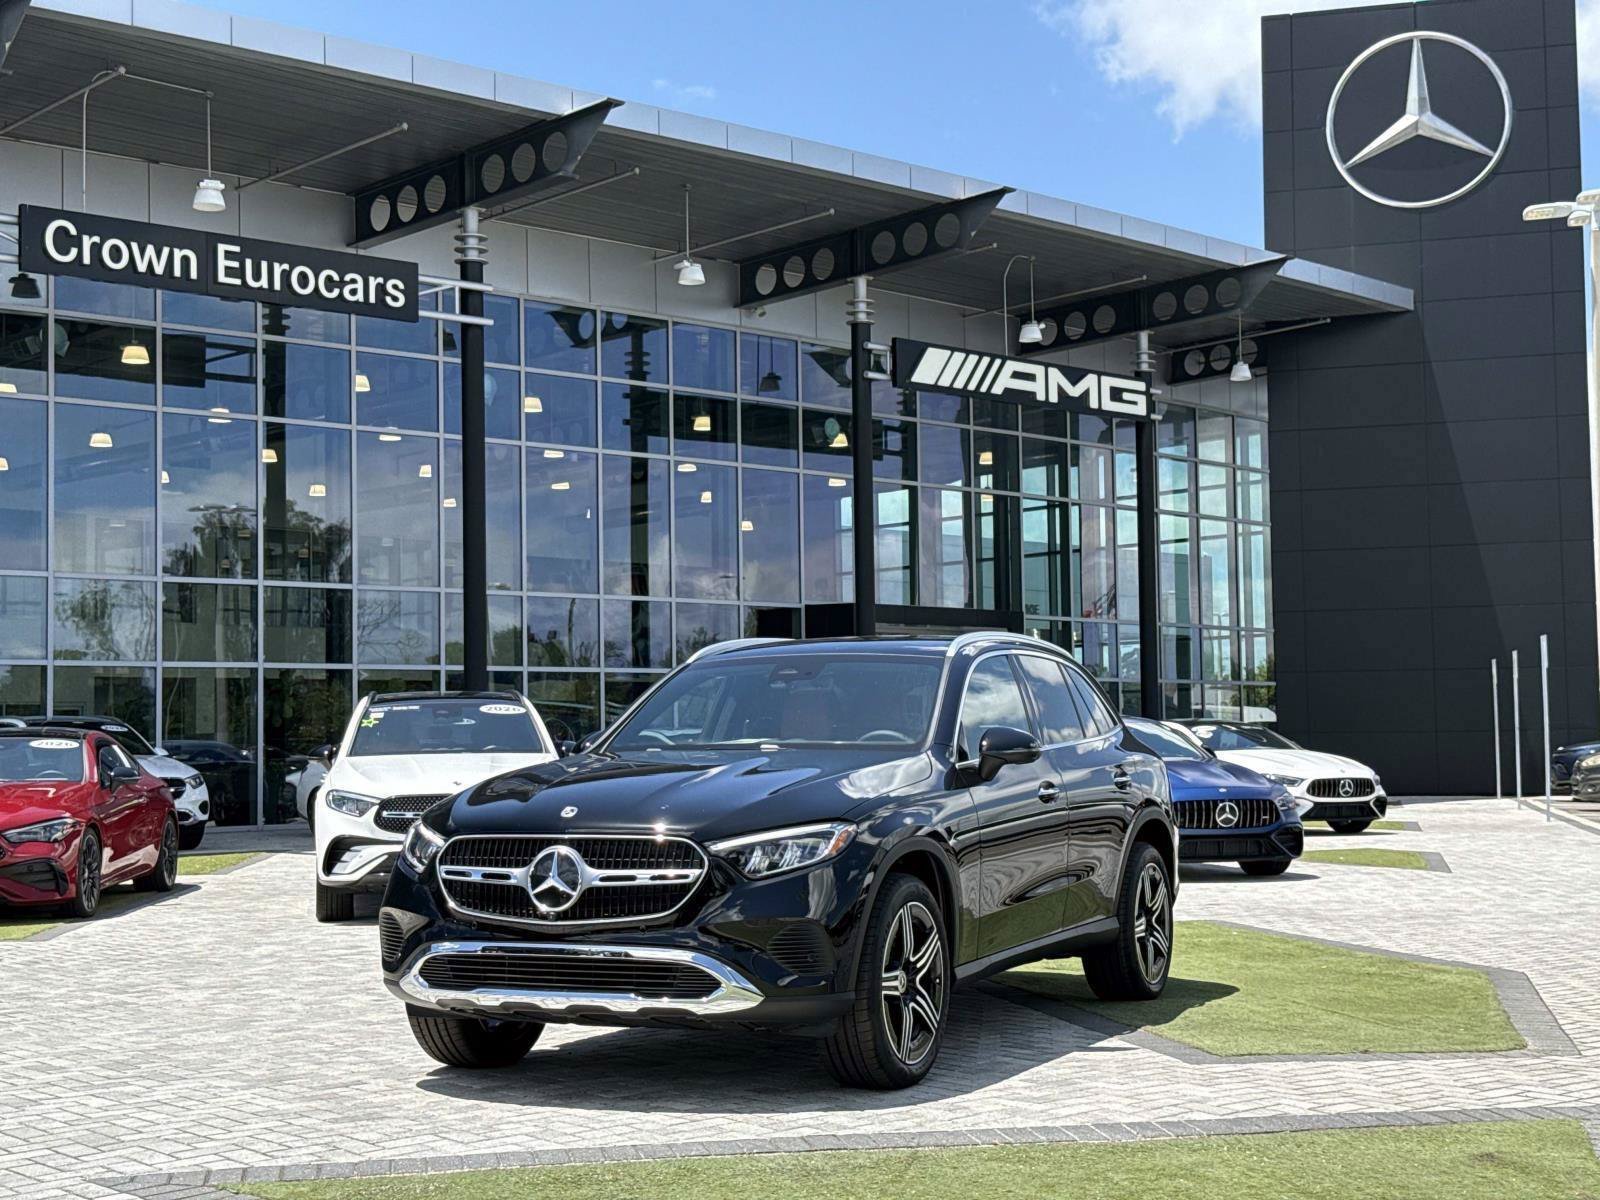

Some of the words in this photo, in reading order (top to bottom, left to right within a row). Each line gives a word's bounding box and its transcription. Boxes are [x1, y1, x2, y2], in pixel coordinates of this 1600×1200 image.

[46, 219, 198, 280] Crown
[217, 243, 406, 308] Eurocars
[990, 359, 1147, 416] AMG
[484, 705, 522, 713] 2026
